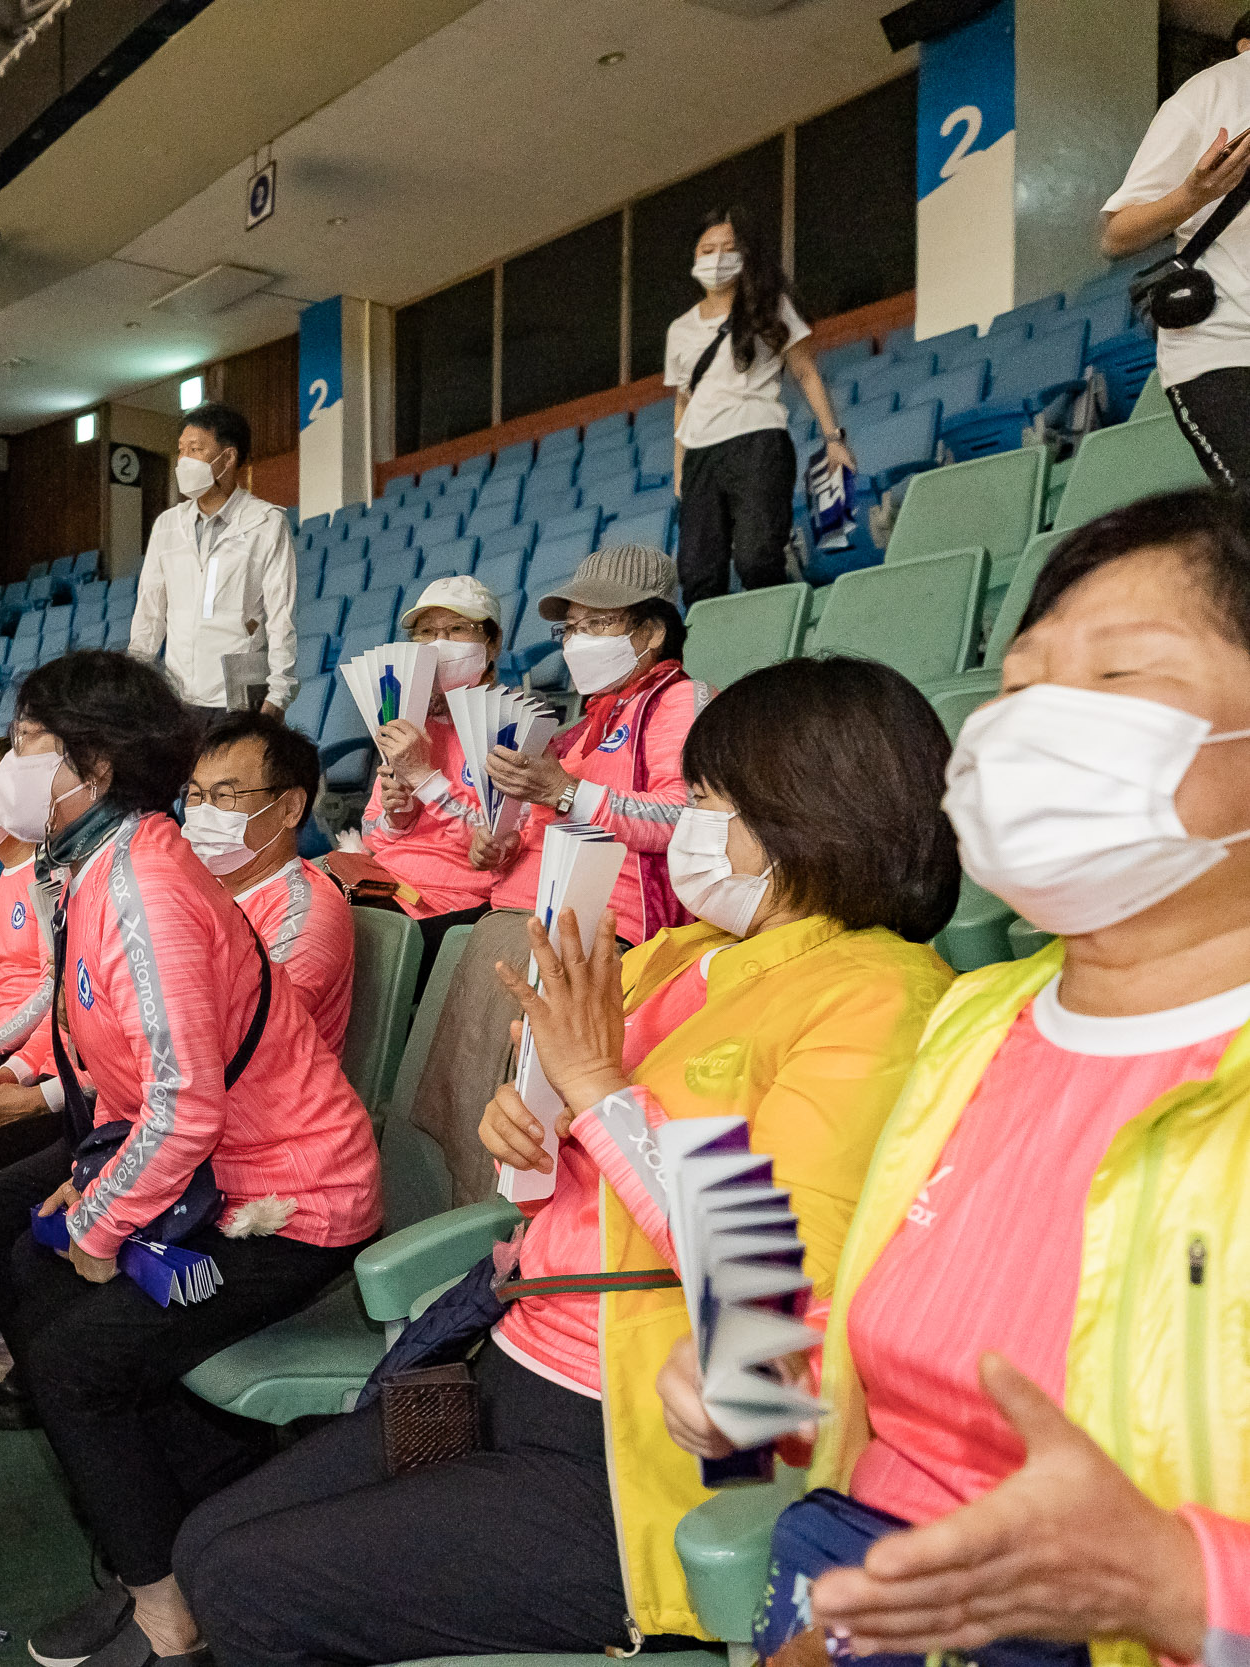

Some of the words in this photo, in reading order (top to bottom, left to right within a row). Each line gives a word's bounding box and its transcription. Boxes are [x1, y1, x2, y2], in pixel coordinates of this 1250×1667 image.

[939, 105, 983, 179] 2
[308, 378, 329, 422] 2
[120, 453, 132, 477] 2
[131, 948, 160, 1032] stomax
